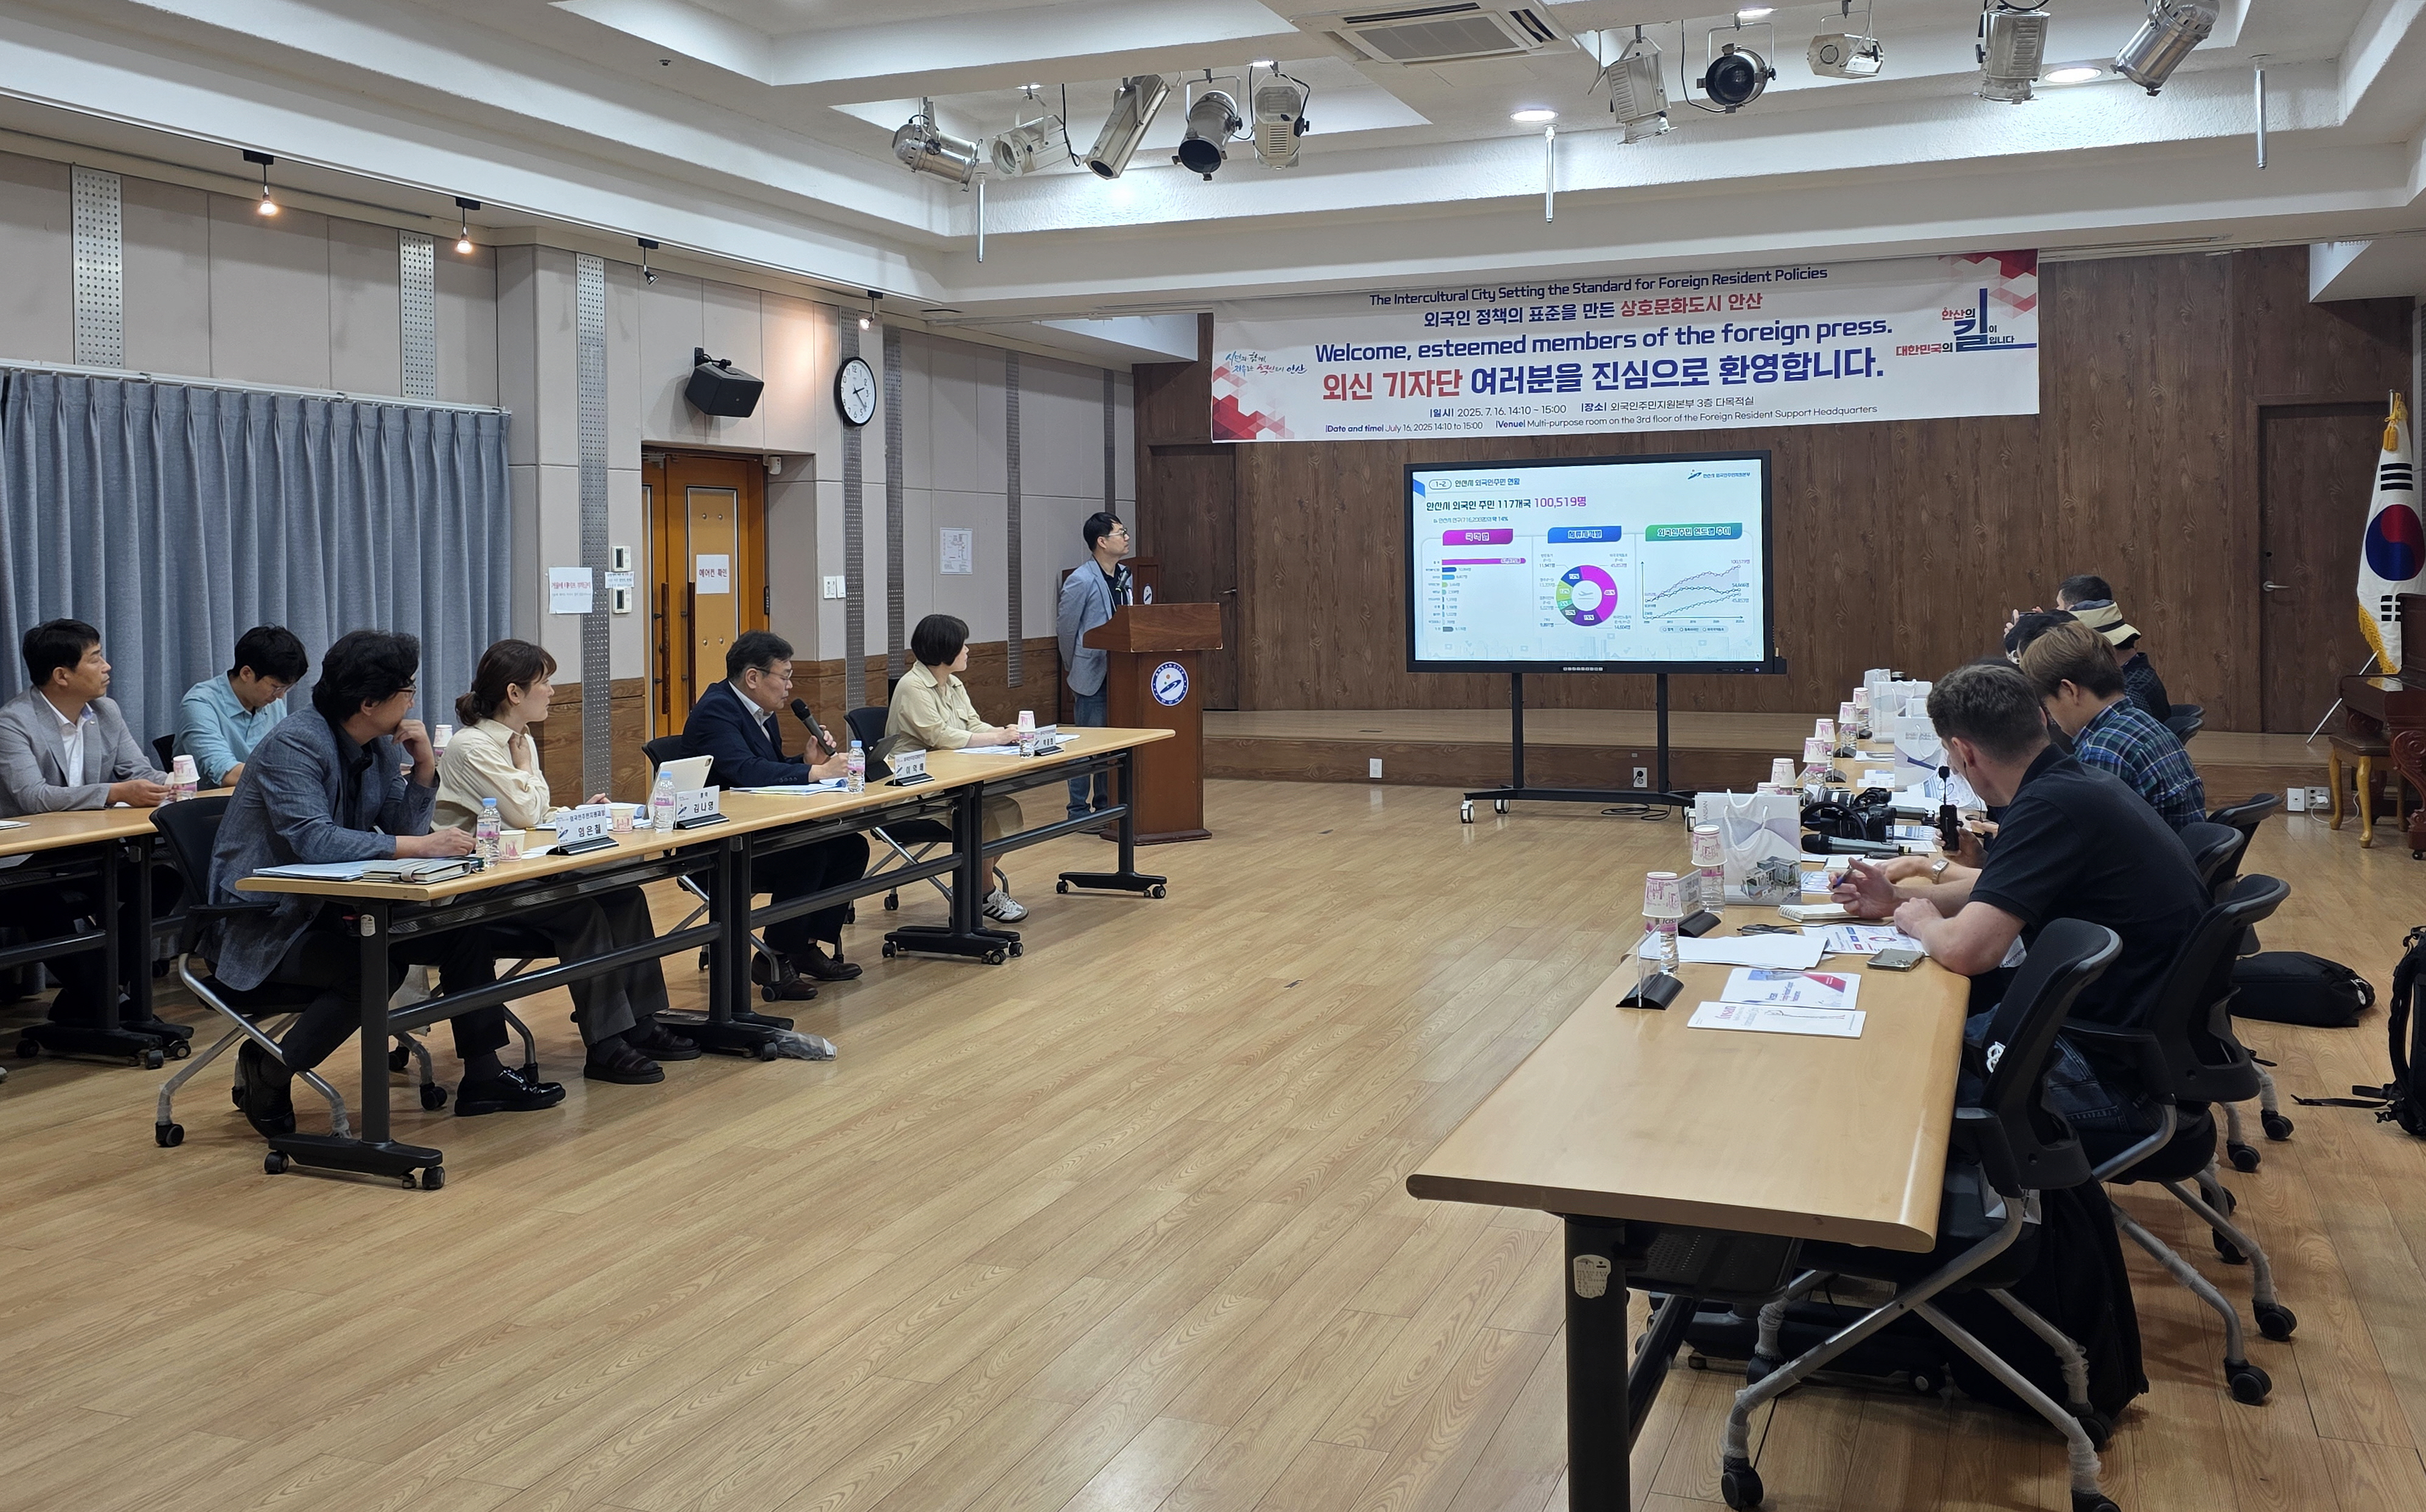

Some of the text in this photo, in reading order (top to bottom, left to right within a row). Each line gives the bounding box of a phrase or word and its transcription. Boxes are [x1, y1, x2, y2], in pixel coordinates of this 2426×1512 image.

[1370, 267, 1827, 305] The Intercultural City Setting the Standard for Foreign Resident Policies
[1424, 293, 1763, 327] 외국인 정책의 표준을 만든 상호문화도시 안산
[1942, 307, 1976, 321] 안산의
[1316, 319, 1892, 362] Welcome, esteemed members of the foreign press.
[1989, 335, 2015, 344] 입니다
[1895, 342, 1953, 356] 대한민국의
[1286, 364, 1308, 374] 안산
[1323, 347, 1884, 401] 외신 기자단 여러분을 진심으로 환영합니다.
[1457, 408, 1483, 417] 2025.
[1485, 408, 1493, 416] 7.
[1494, 407, 1506, 416] 16.
[1508, 406, 1531, 415] 14:10
[1541, 405, 1567, 414] 15:00
[1611, 399, 1695, 411] 외국인주민지원본부
[1696, 398, 1713, 408] 3층
[1716, 396, 1754, 407] 다목적실
[1527, 419, 1584, 428] Multi-purpose
[1636, 416, 1651, 424] 3rd
[1700, 412, 1733, 423] Foreign
[1735, 410, 1773, 420] Resident
[1775, 408, 1811, 419] Support
[1813, 405, 1878, 417] Headquarters
[1385, 424, 1401, 433] July
[1475, 478, 1506, 487] 외국인주민
[1426, 496, 1587, 511] 안산시 외국인 주민 117개국 100,519명
